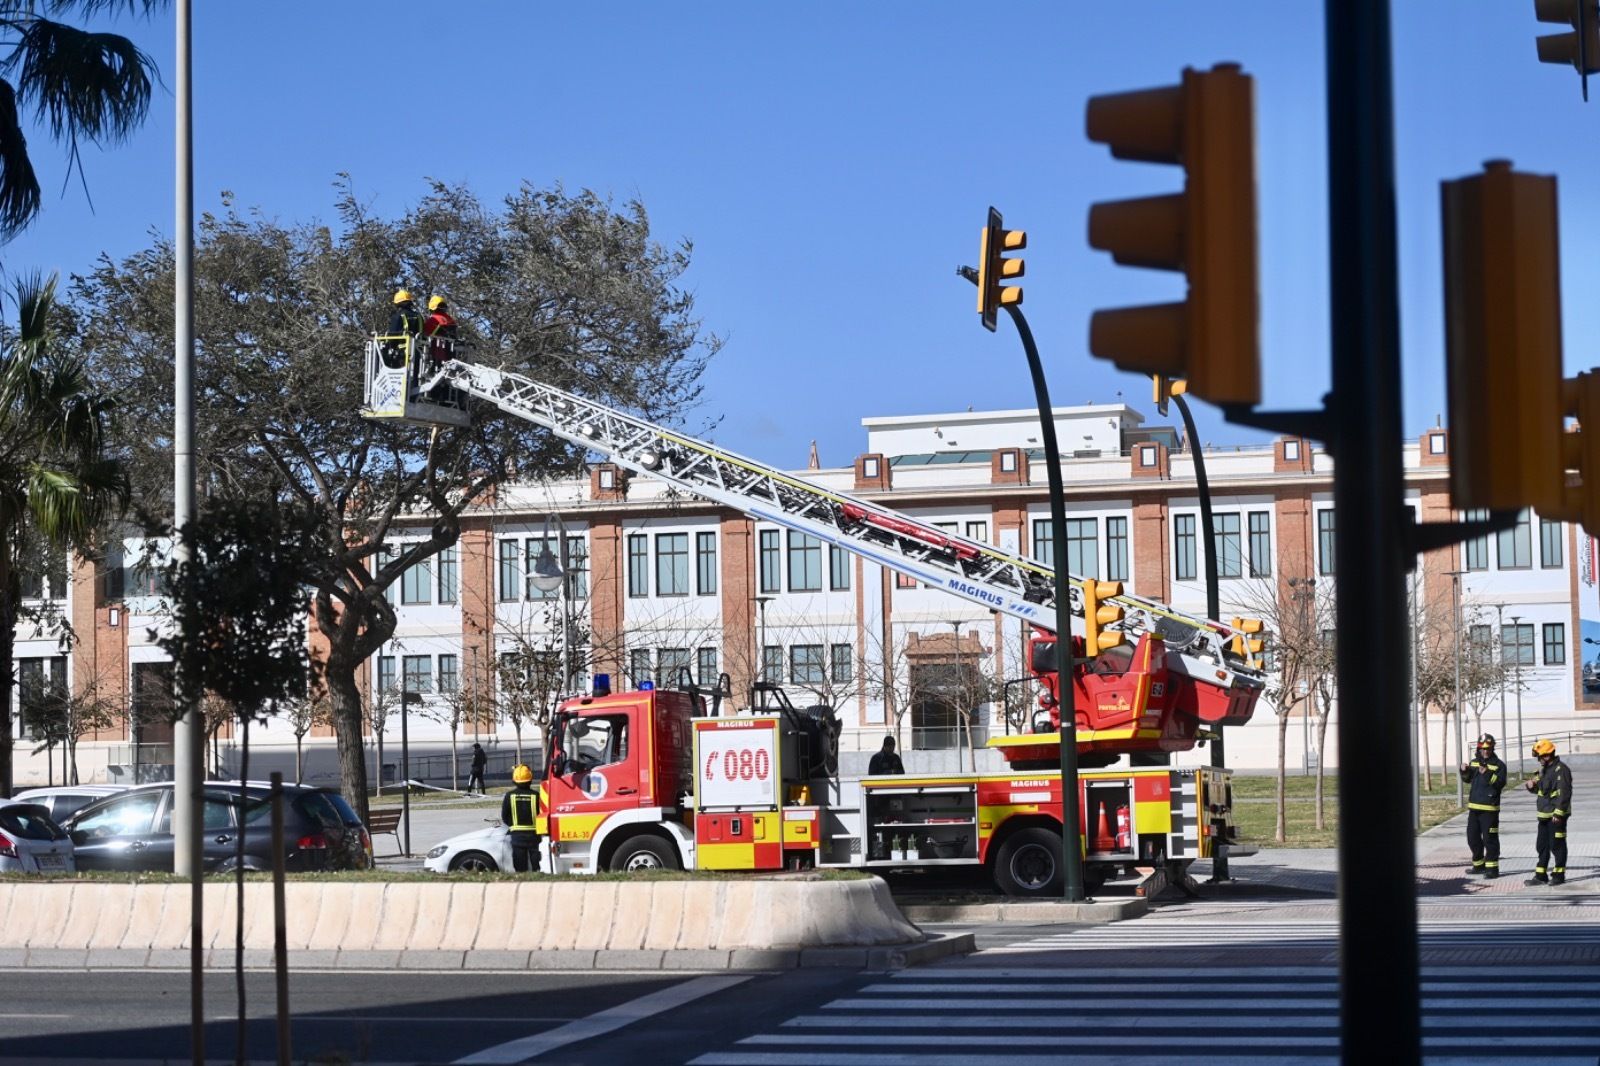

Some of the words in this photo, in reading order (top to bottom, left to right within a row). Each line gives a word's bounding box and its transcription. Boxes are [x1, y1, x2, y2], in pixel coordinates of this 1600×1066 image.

[948, 579, 1004, 606] MAGIRUS
[717, 720, 754, 728] MAGIRUS
[724, 748, 769, 782] 080
[1010, 780, 1050, 788] MAGIRUS
